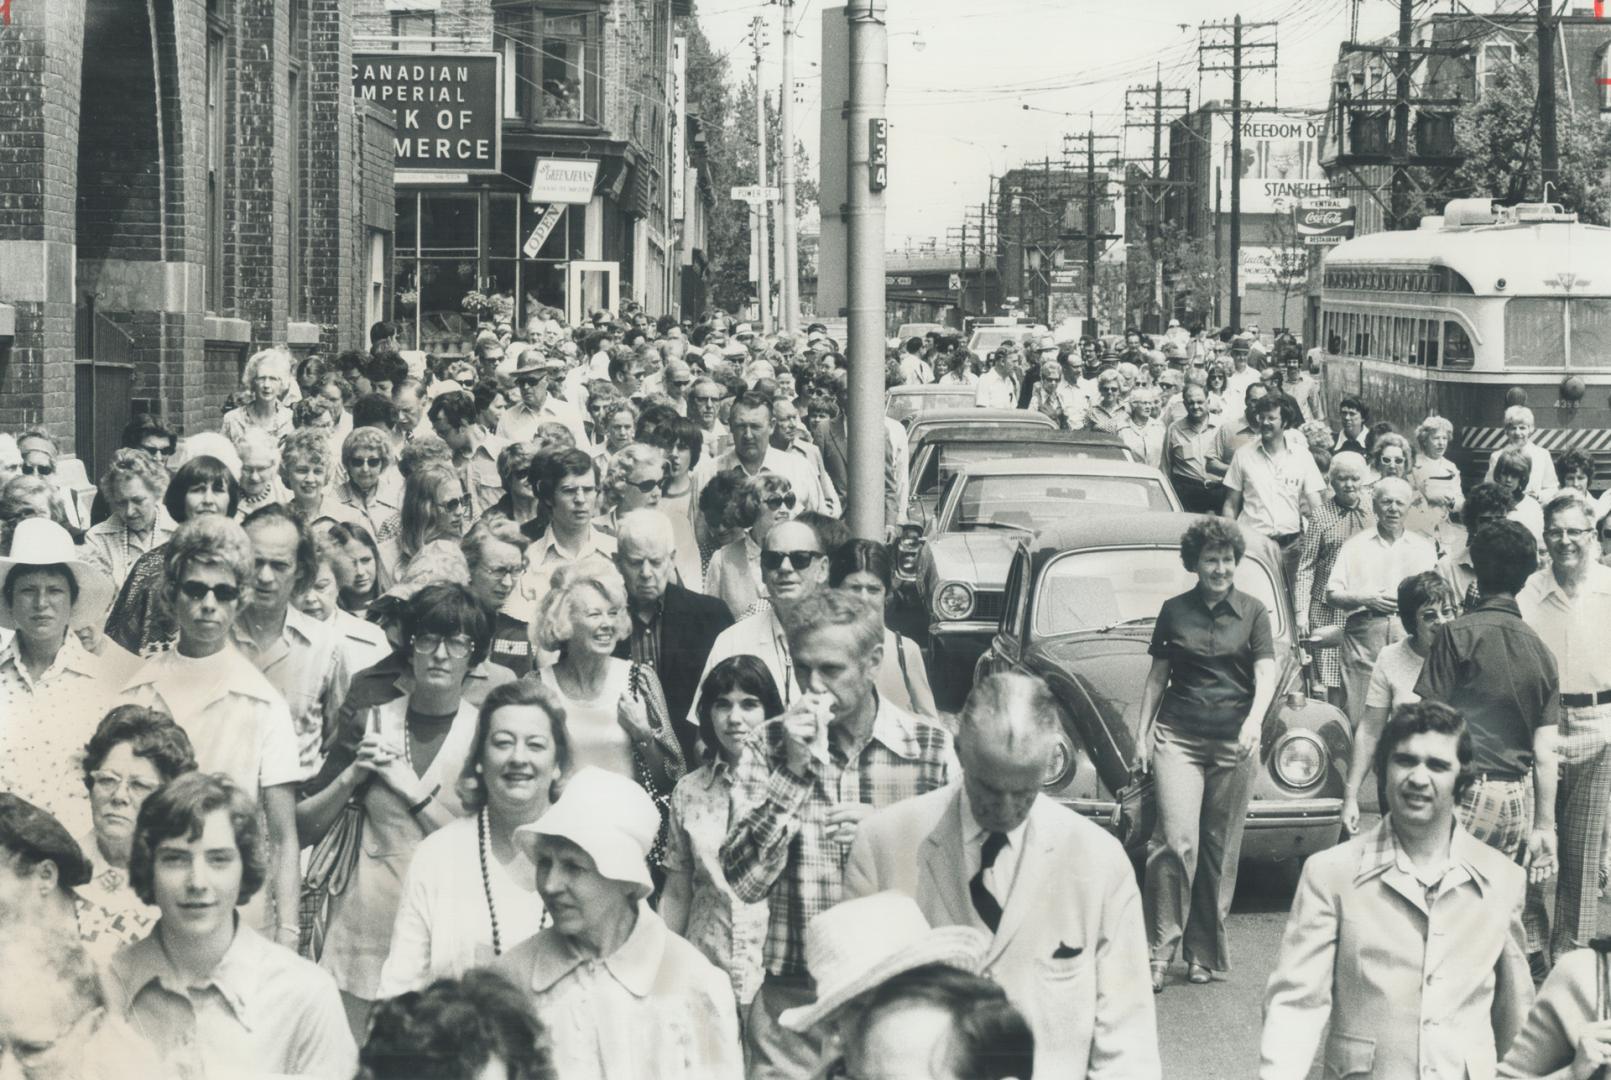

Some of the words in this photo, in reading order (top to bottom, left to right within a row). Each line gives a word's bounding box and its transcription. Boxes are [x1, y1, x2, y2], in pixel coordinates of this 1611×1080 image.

[351, 64, 468, 82] CANADIAN
[351, 85, 465, 102] IMPERIAL
[436, 109, 472, 130] OF
[1243, 124, 1302, 138] REEDOM
[394, 138, 489, 159] MERCE
[876, 119, 887, 187] 334
[1264, 183, 1330, 198] STANFIEL
[1305, 211, 1342, 225] Coca-Cola
[529, 205, 560, 251] OPEN
